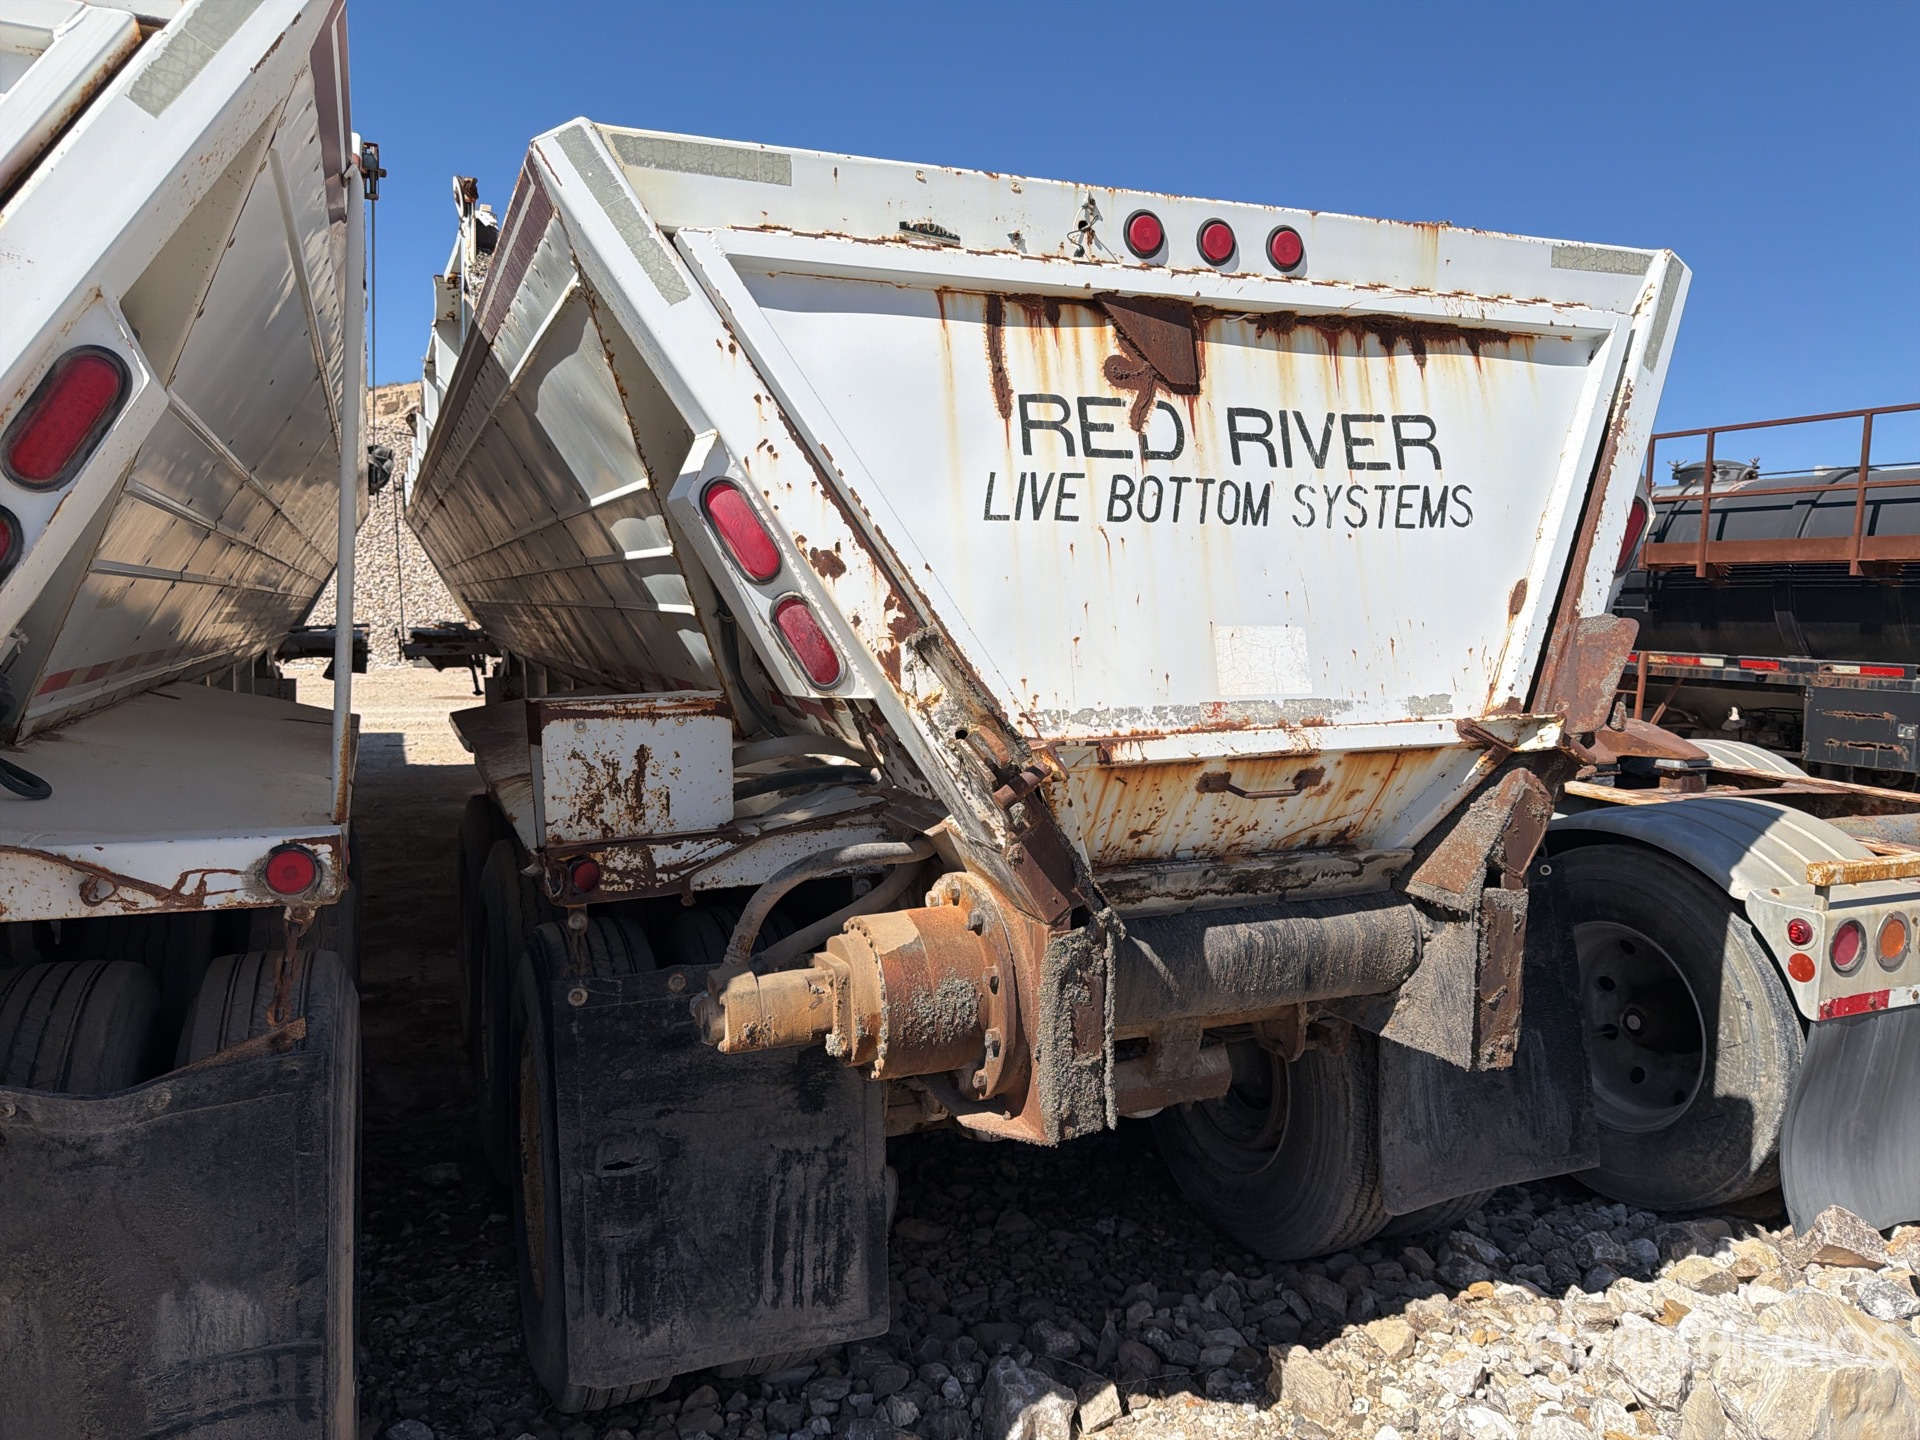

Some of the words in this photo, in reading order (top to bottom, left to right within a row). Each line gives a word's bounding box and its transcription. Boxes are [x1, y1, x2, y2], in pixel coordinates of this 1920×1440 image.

[1018, 394, 1185, 460] RED
[1227, 407, 1442, 470] RIVER
[983, 472, 1085, 521] LIVE
[1107, 474, 1271, 527] BOTTOM
[1292, 484, 1473, 529] SYSTEMS
